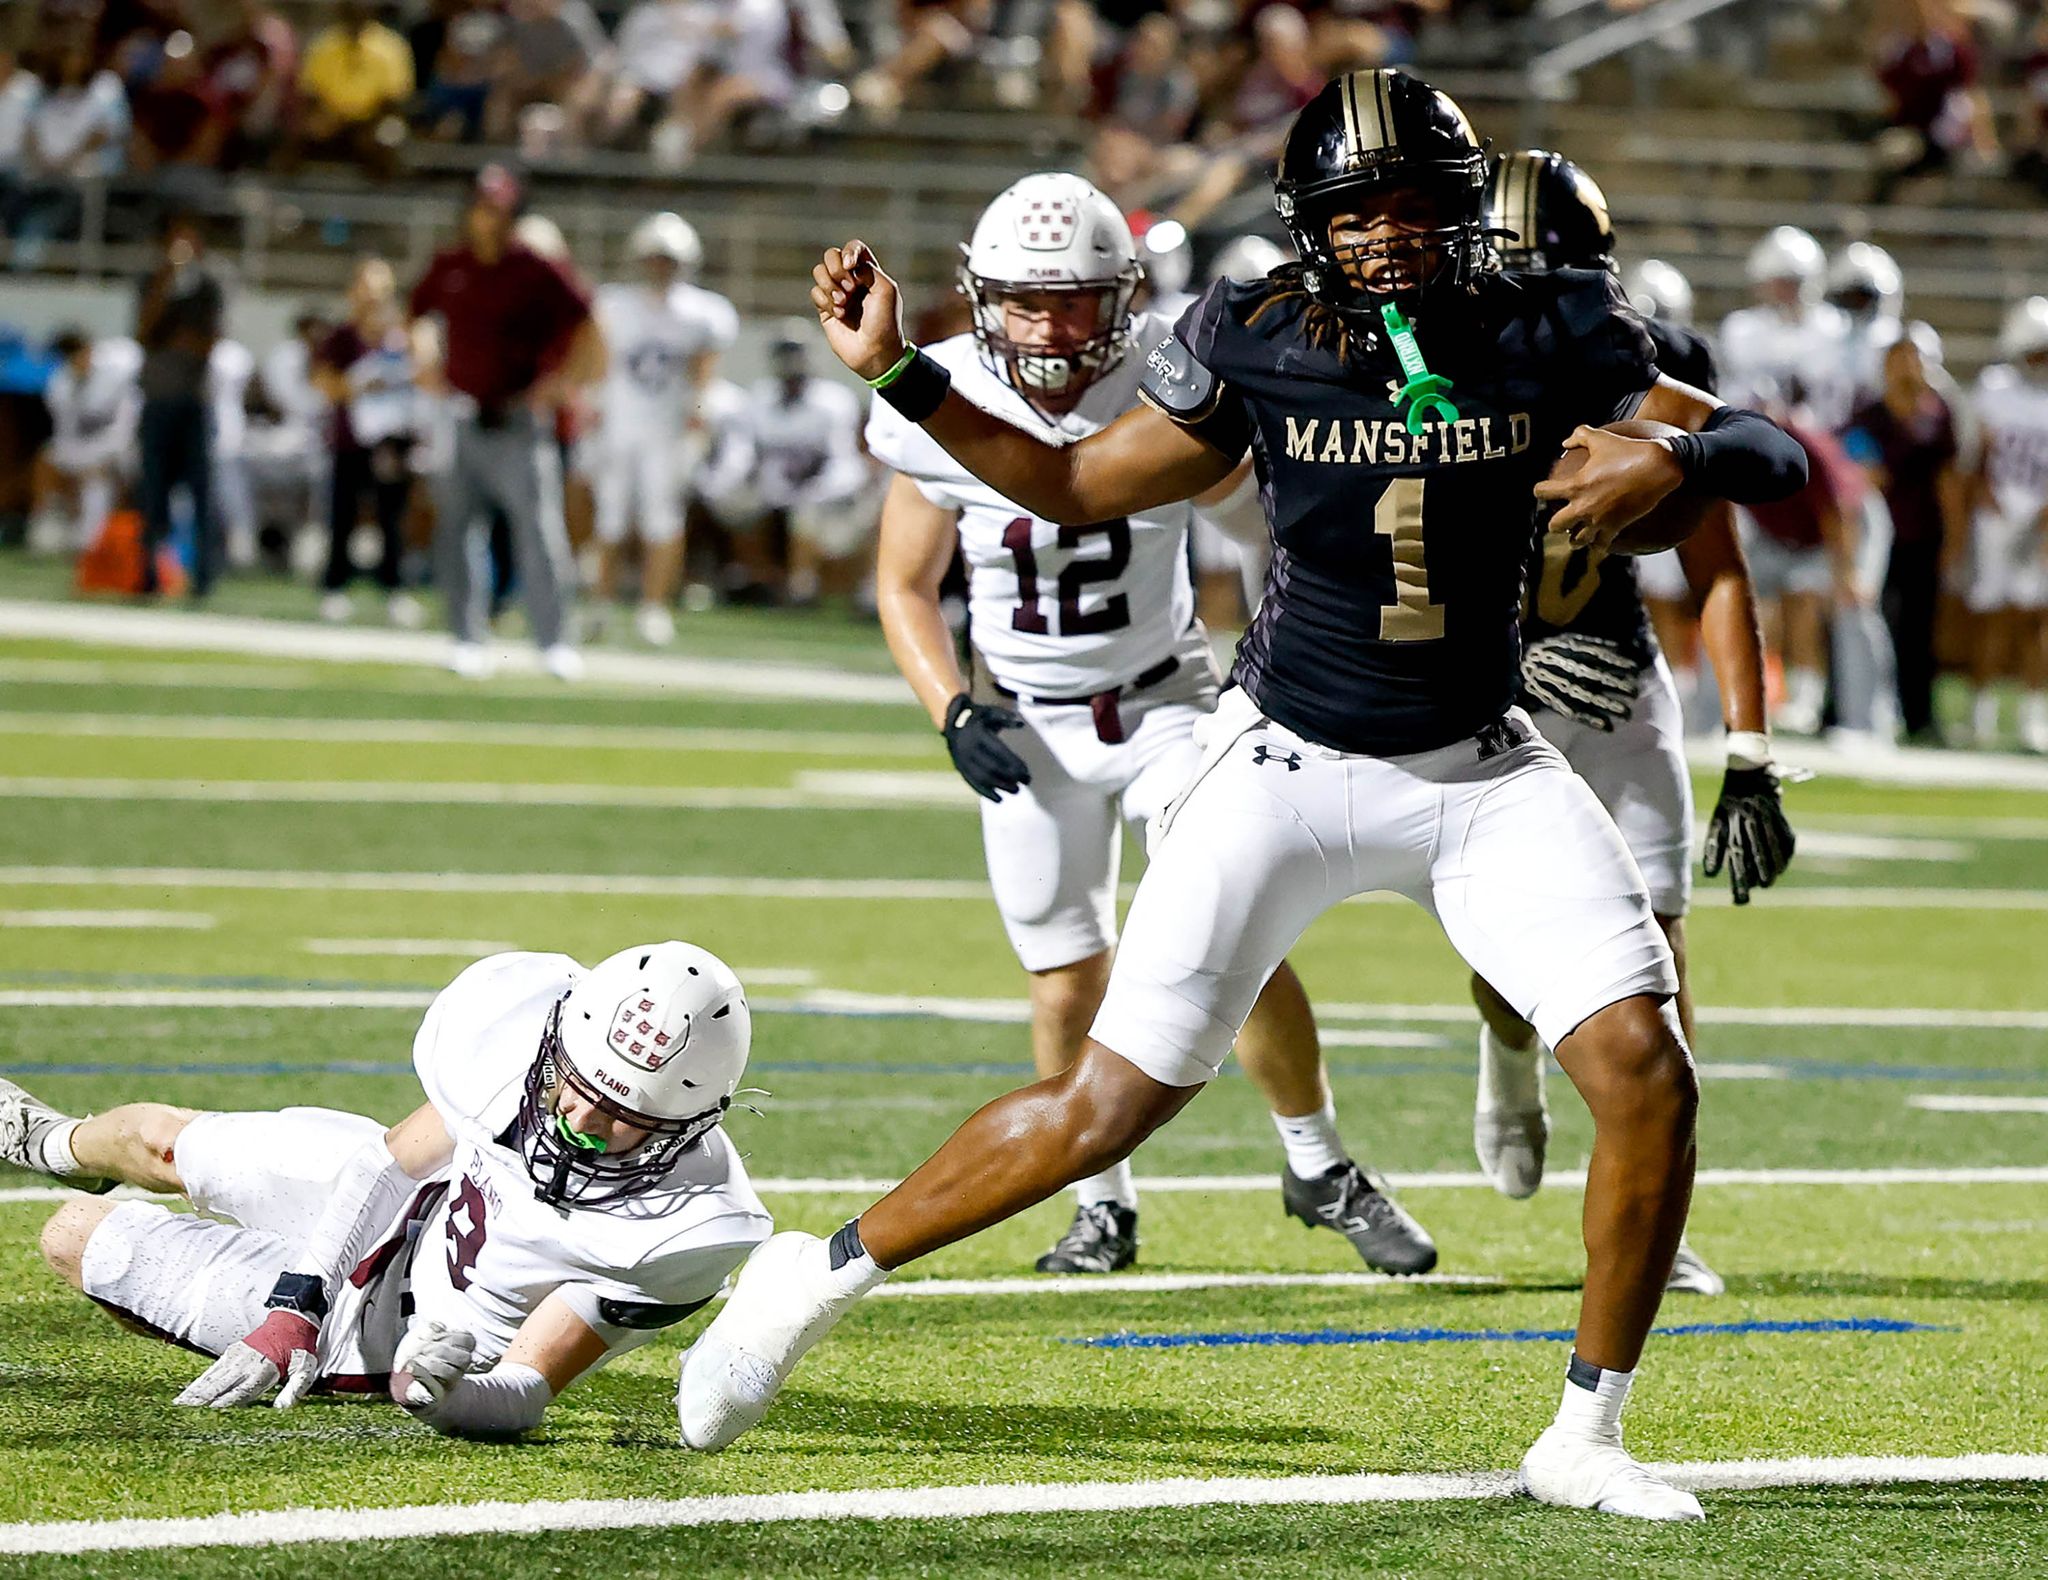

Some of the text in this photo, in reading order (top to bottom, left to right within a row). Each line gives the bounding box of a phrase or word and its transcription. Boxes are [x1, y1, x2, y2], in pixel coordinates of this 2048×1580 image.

[1394, 331, 1425, 376] NXTRND
[1286, 412, 1531, 464] MANSFIELD
[1002, 517, 1132, 637] 12
[1374, 478, 1447, 642] 1
[594, 1068, 630, 1097] PLANO
